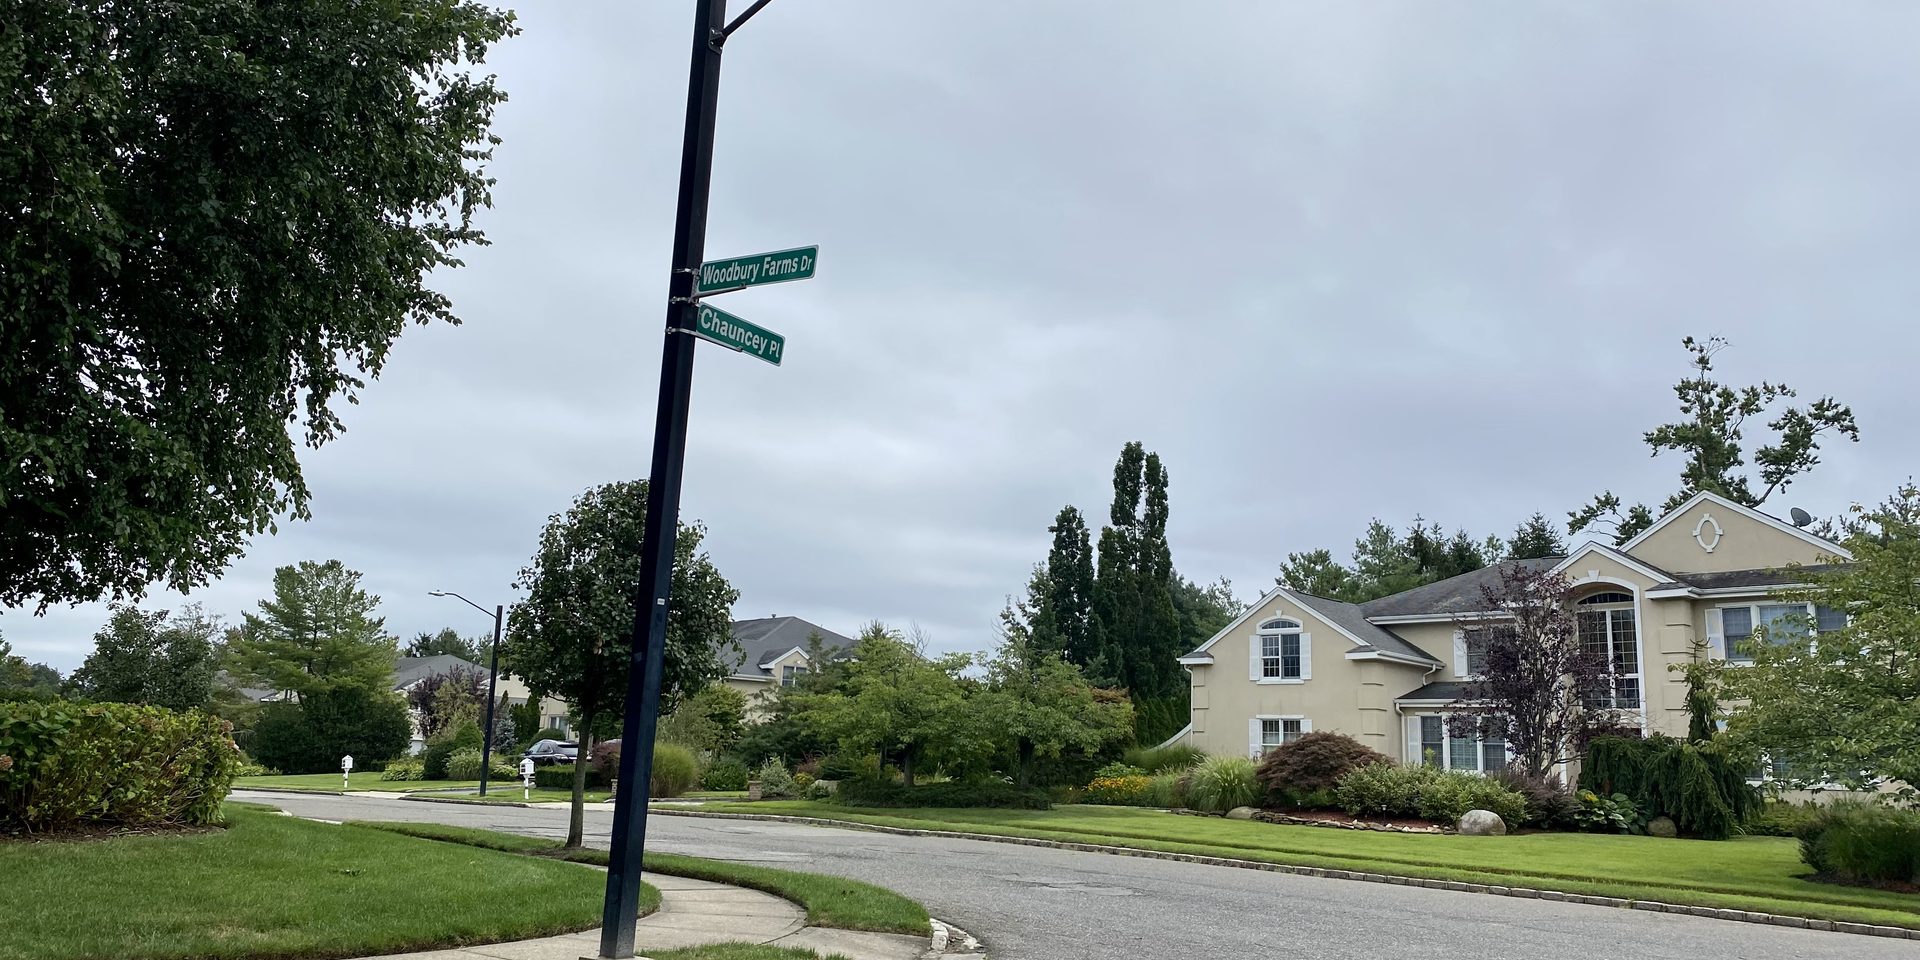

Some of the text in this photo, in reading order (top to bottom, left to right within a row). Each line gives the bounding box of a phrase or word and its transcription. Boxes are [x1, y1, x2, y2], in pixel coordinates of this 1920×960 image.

[703, 255, 813, 285] Woodbury Farms Dr
[700, 308, 780, 358] Chauncey Pl
